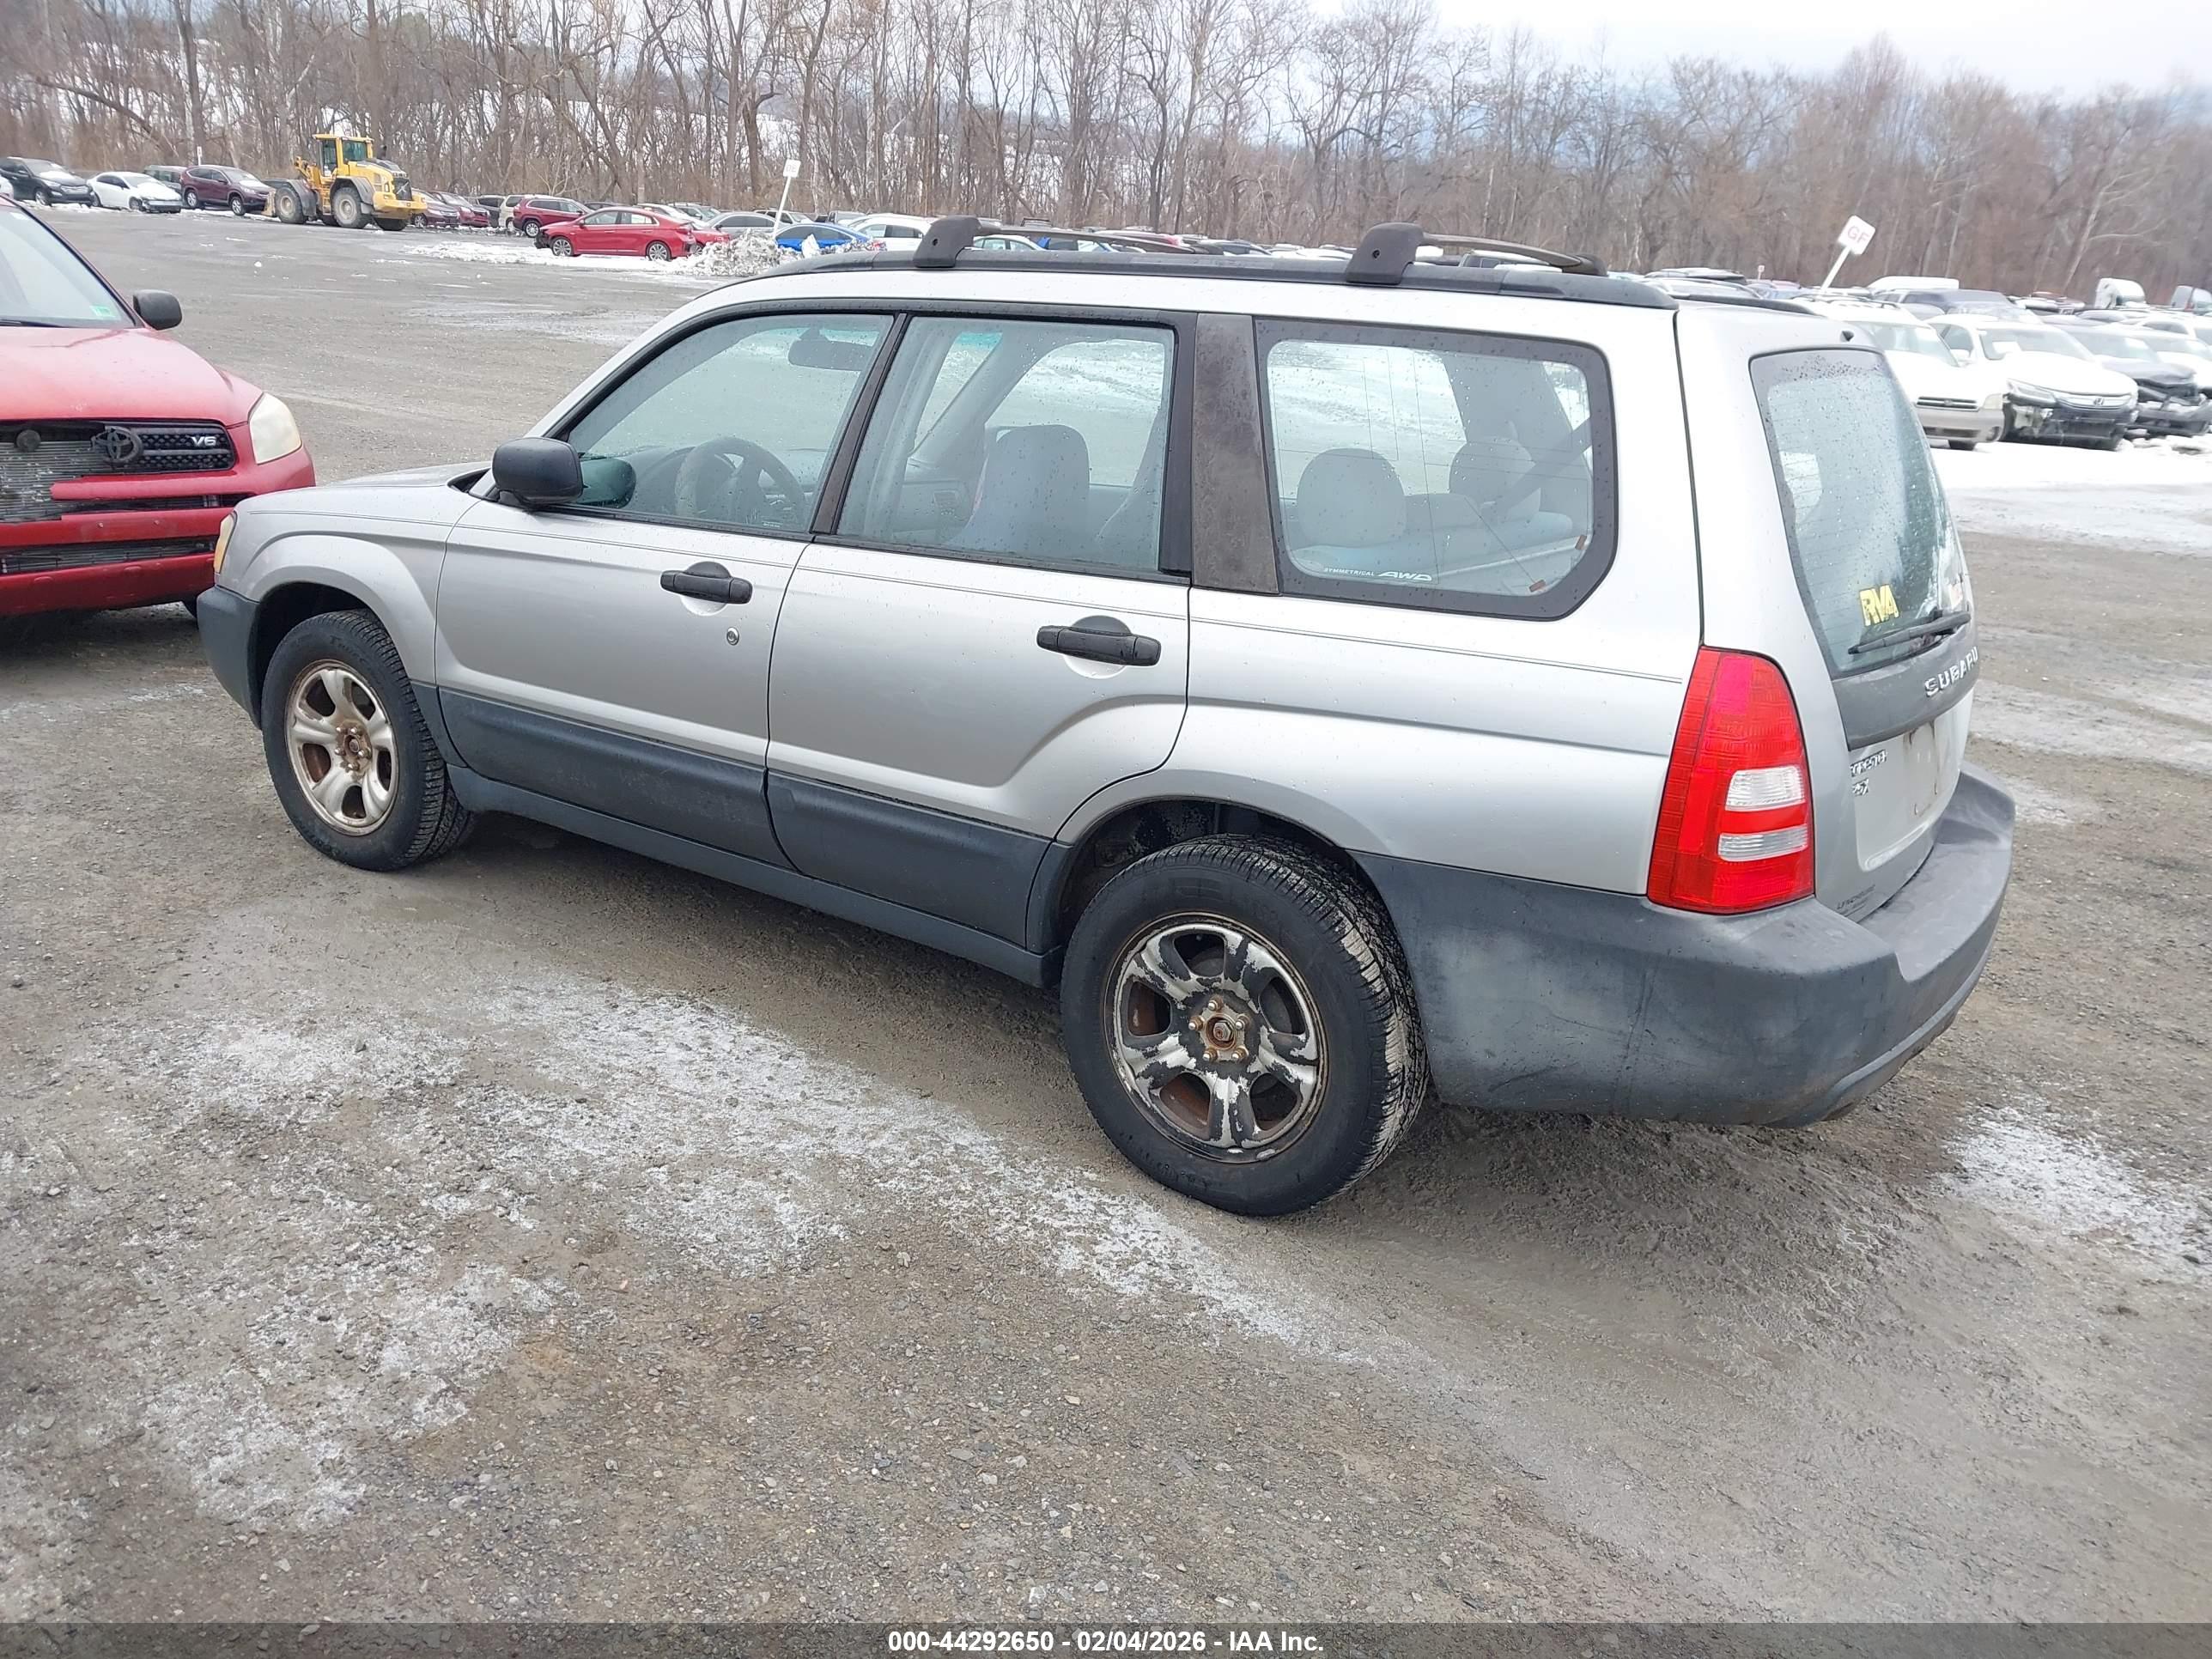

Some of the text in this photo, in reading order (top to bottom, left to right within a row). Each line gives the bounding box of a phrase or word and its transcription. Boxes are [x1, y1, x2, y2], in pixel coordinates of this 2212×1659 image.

[1847, 226, 1870, 243] GF
[191, 436, 216, 447] V6
[1323, 568, 1432, 581] SYMMETRICAL AWD
[1859, 584, 1899, 627] RVA
[1924, 647, 1978, 696] SUBARU
